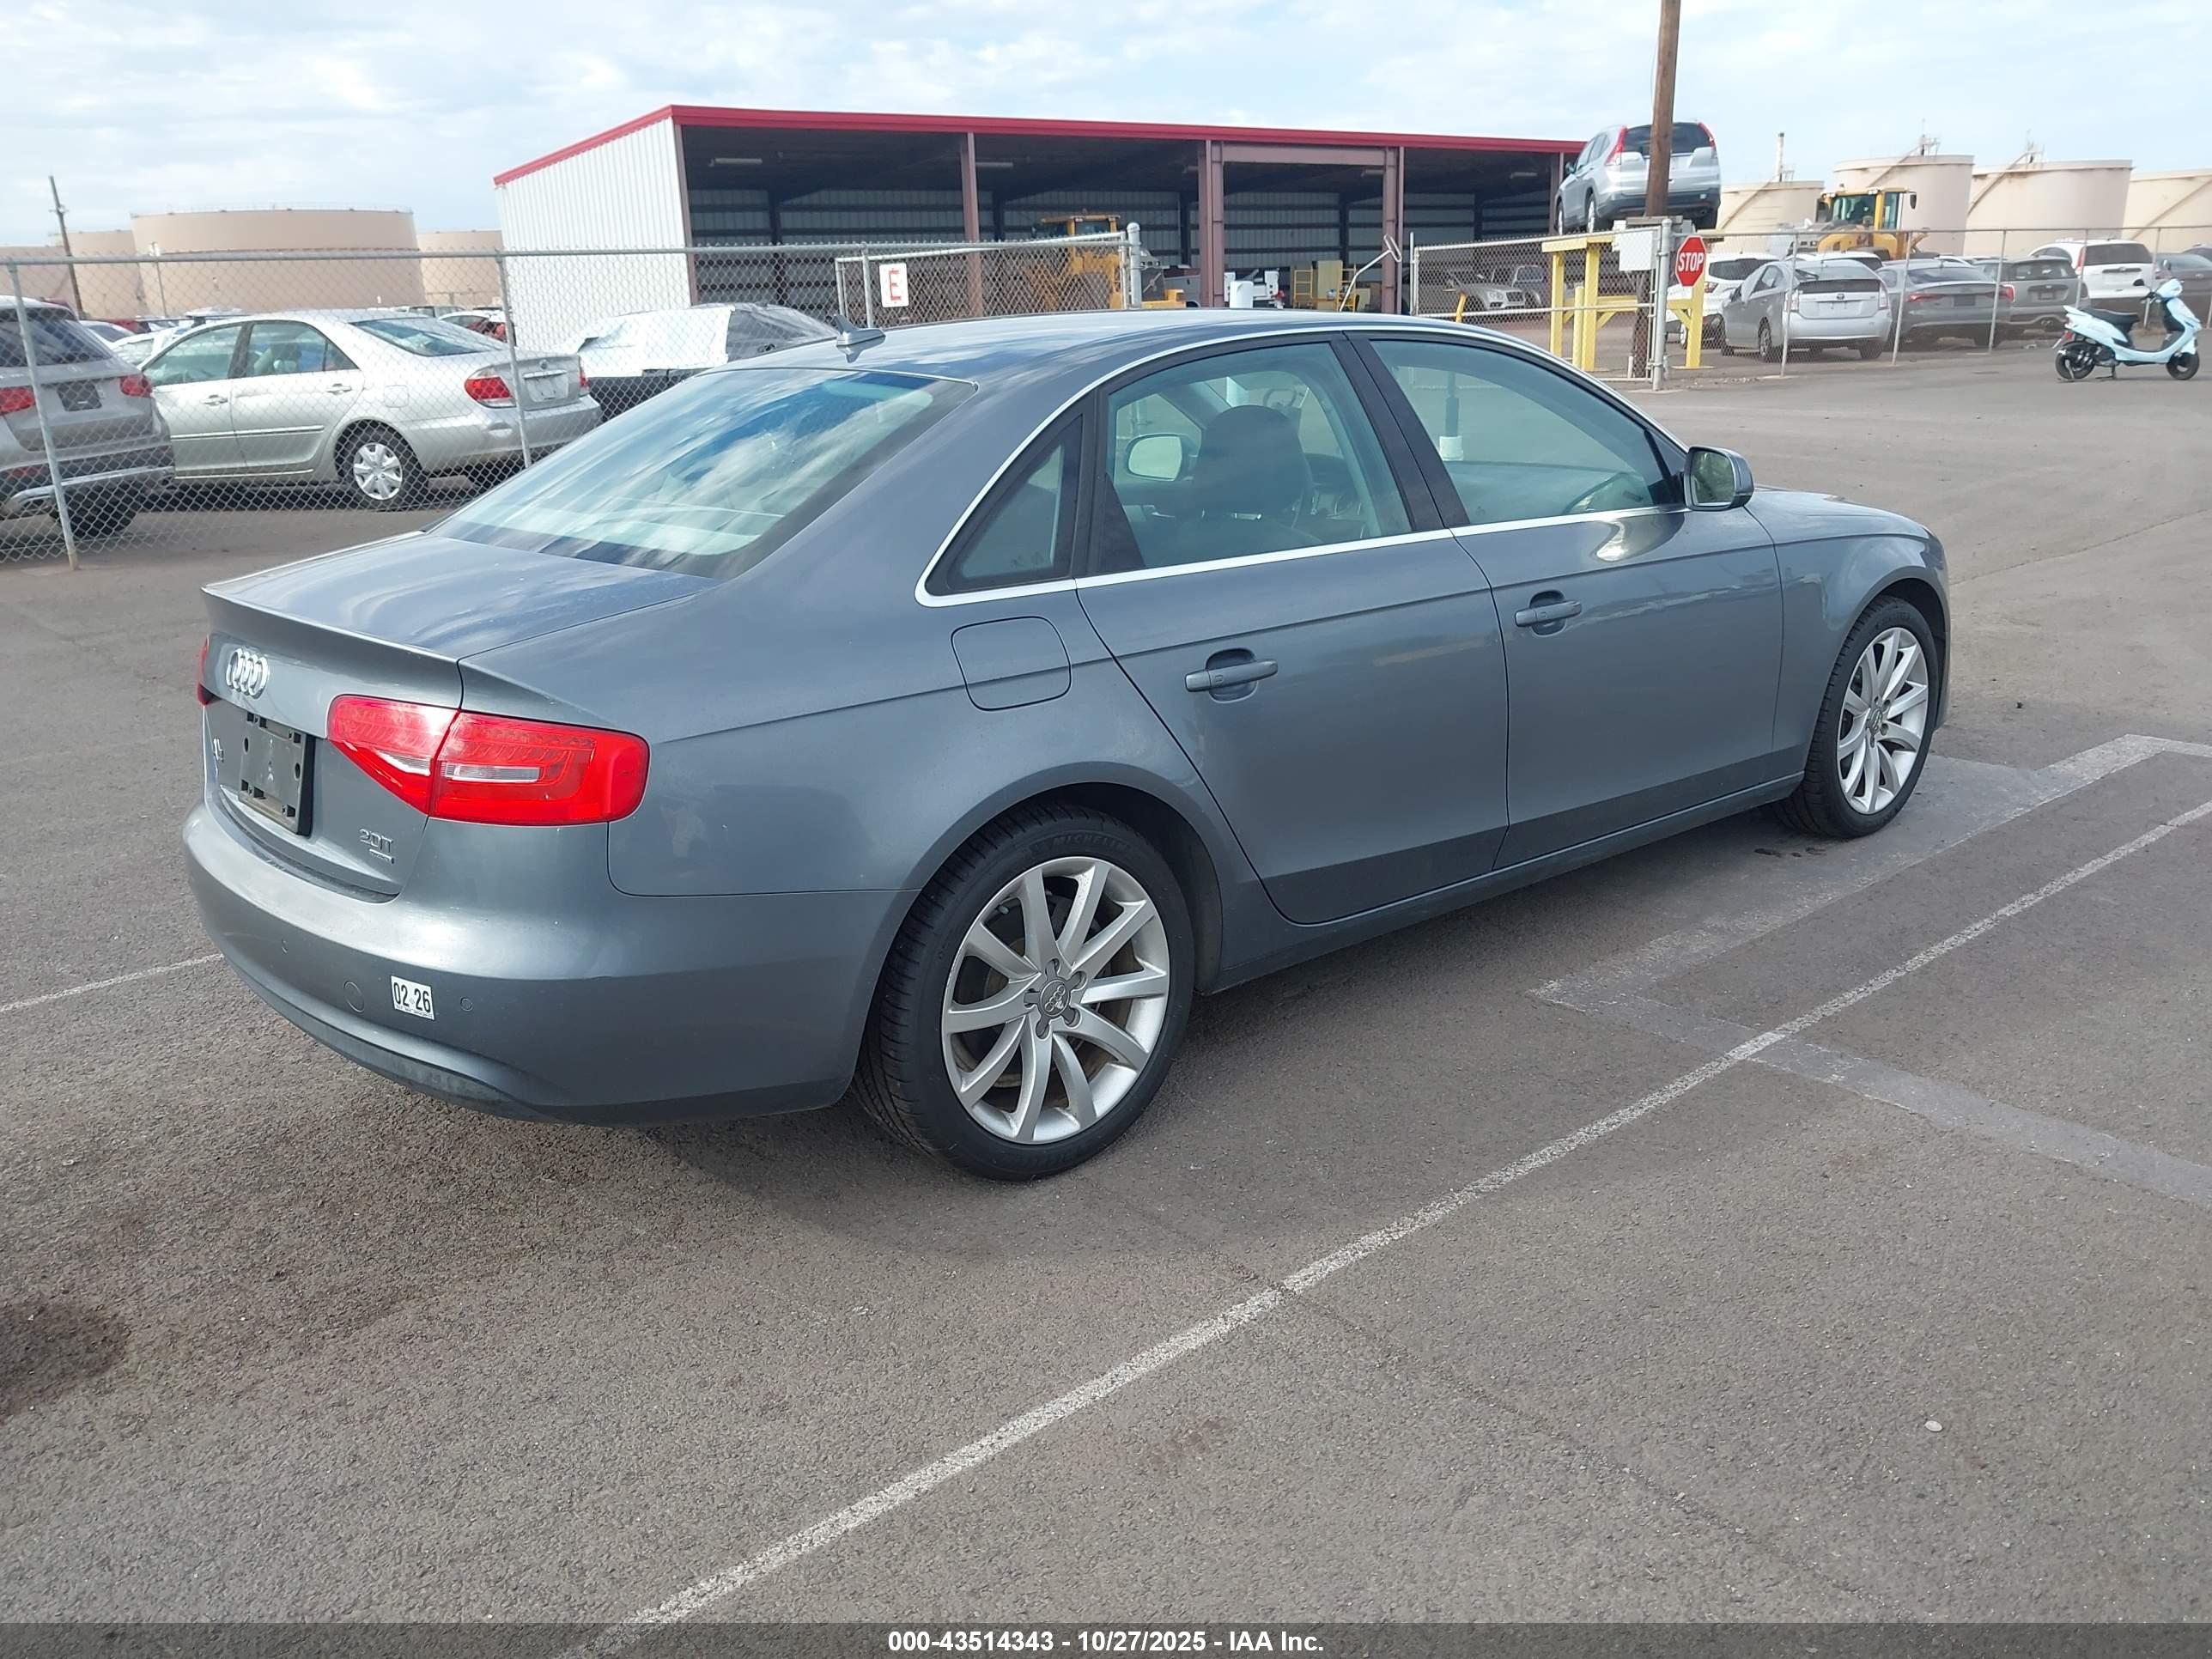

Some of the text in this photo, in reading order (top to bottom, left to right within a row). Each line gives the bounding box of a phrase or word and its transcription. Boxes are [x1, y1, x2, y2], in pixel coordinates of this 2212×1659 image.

[1678, 252, 1705, 272] STOP
[888, 268, 902, 301] E
[393, 981, 410, 1006] 02
[414, 988, 431, 1013] 26
